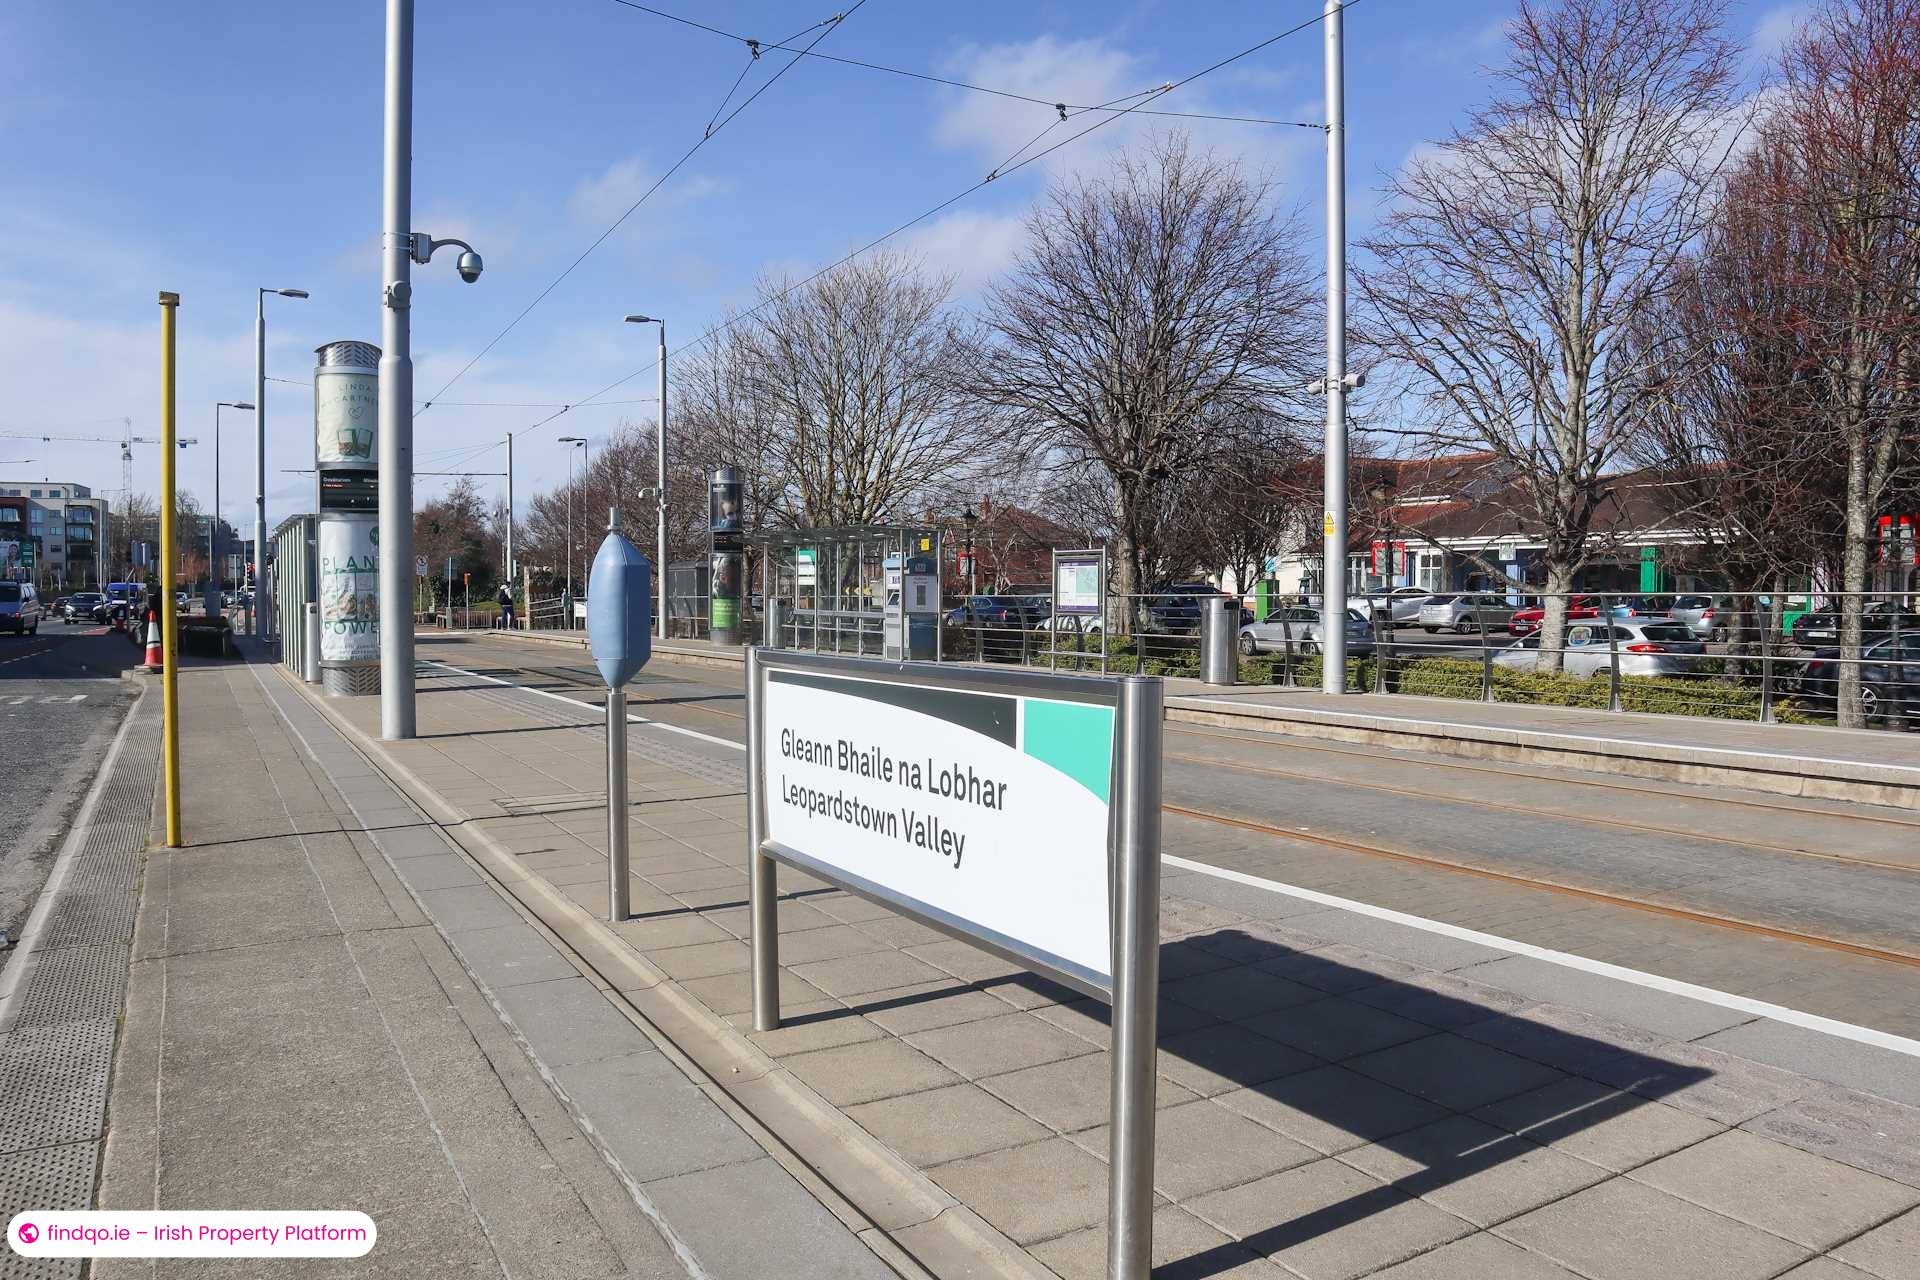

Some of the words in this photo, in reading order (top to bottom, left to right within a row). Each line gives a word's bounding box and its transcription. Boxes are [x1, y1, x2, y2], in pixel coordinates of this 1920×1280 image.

[322, 555, 377, 570] PLAN
[324, 620, 378, 635] POWE
[781, 728, 833, 768] Gleann
[838, 739, 893, 783] Bhaile
[898, 760, 922, 791] na
[928, 758, 1007, 811] Lobhar
[782, 774, 897, 839] Leopardstown
[901, 807, 966, 869] Valley
